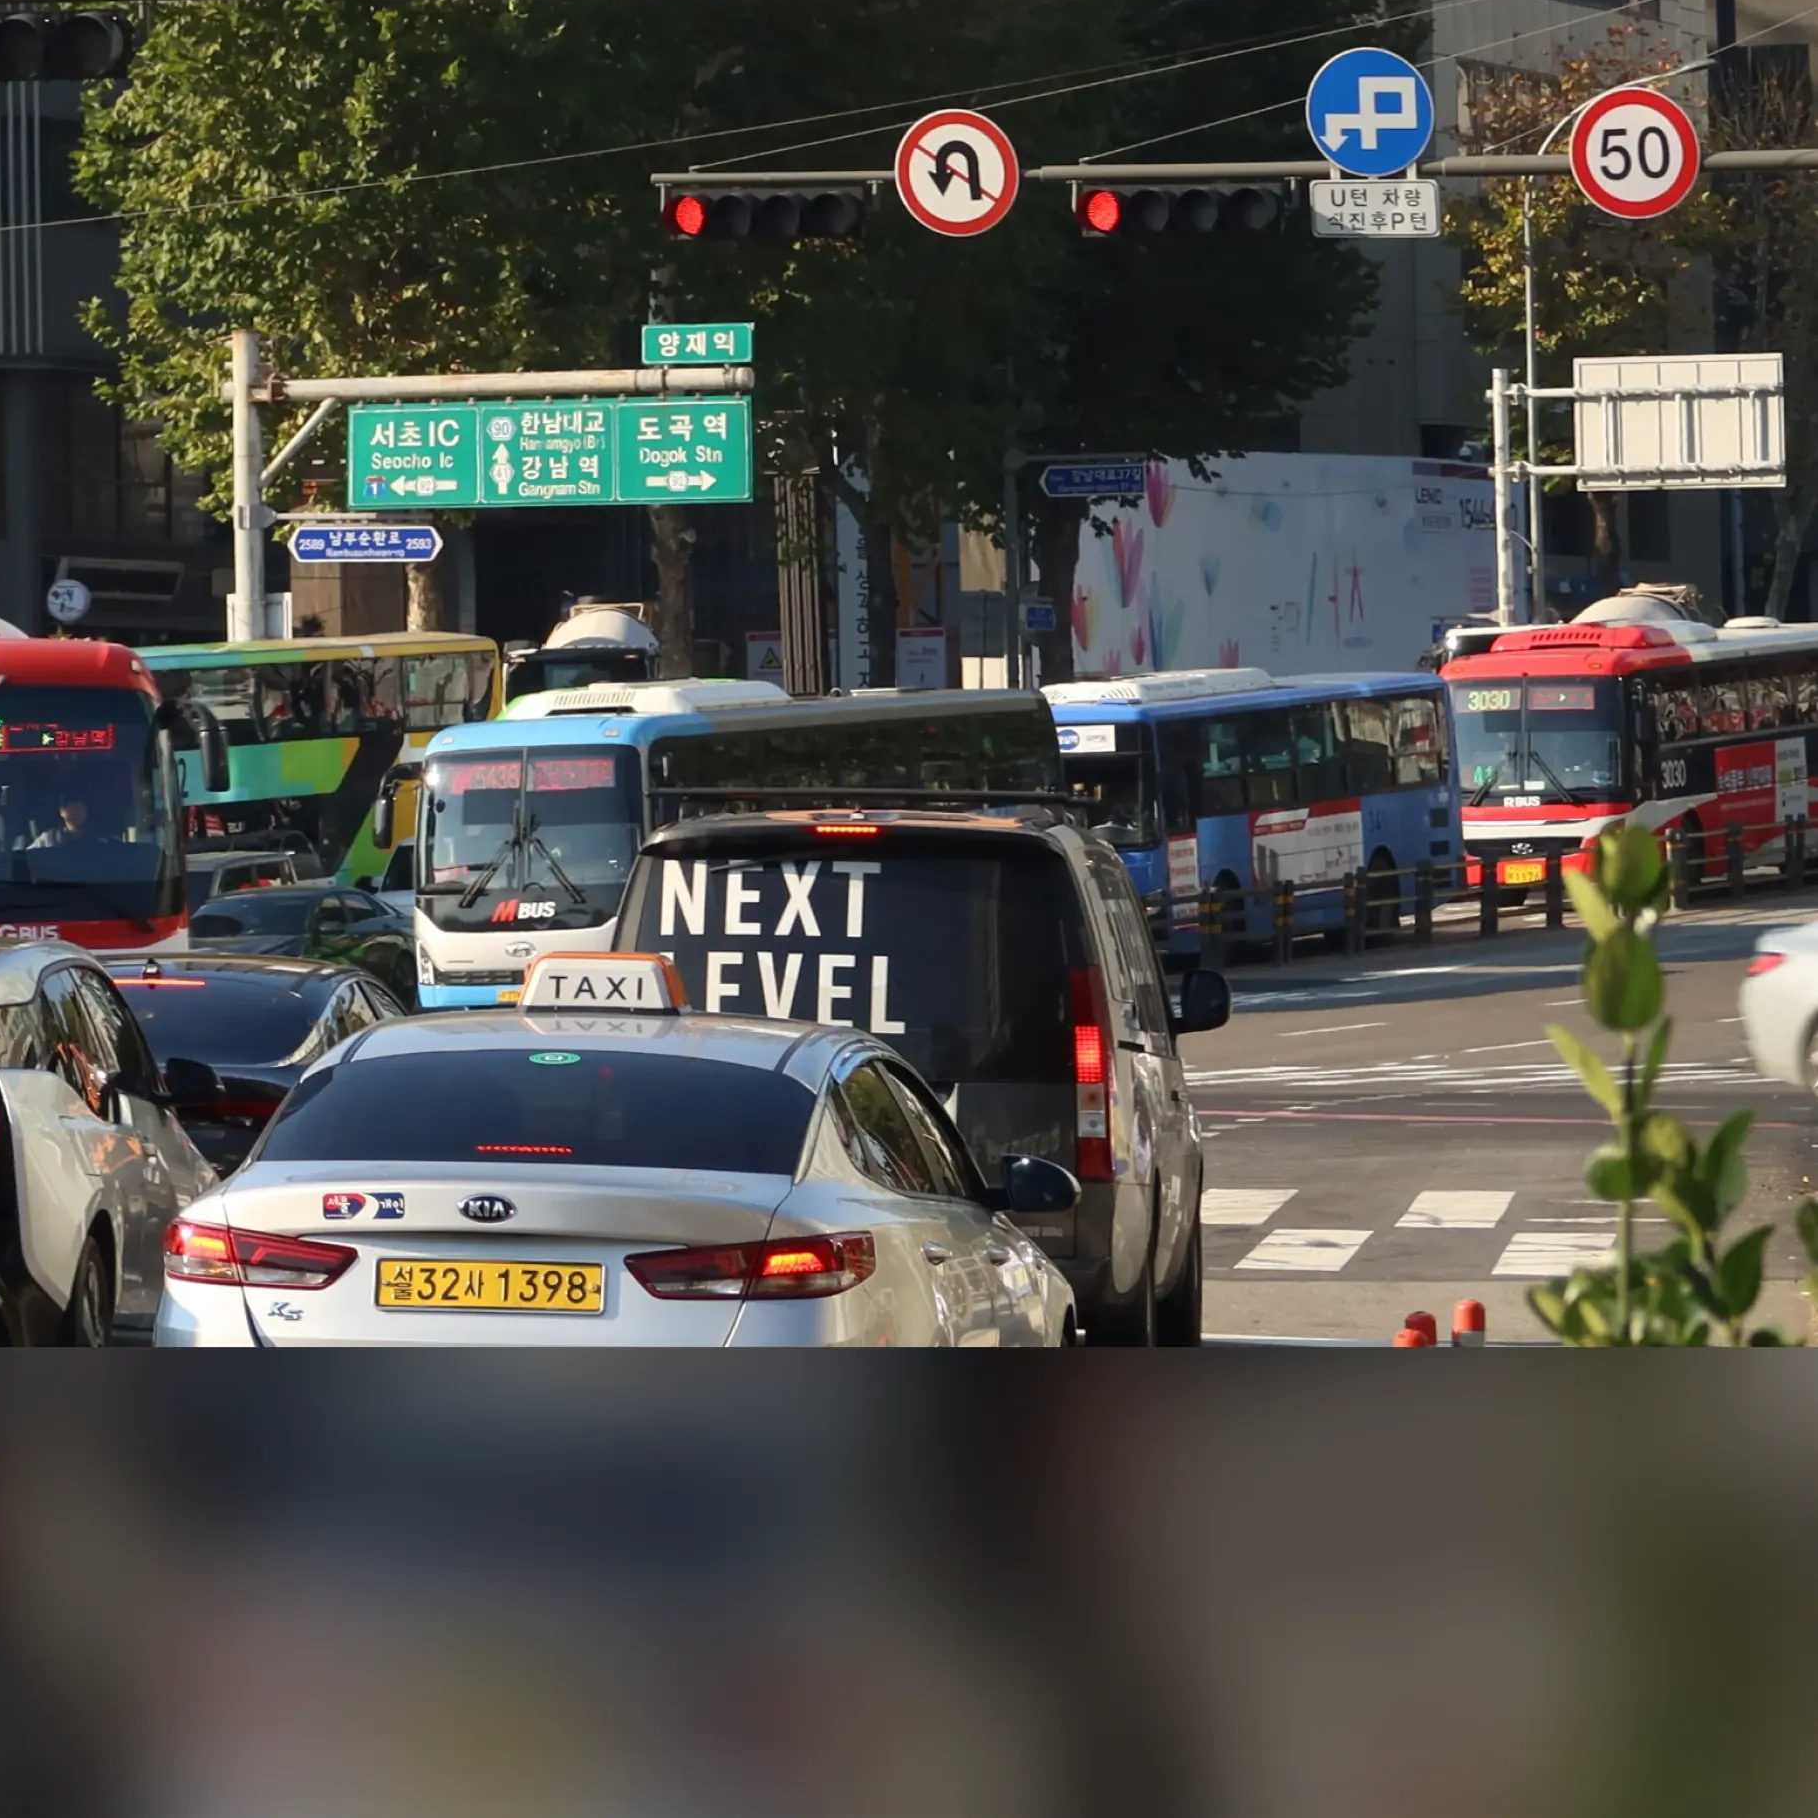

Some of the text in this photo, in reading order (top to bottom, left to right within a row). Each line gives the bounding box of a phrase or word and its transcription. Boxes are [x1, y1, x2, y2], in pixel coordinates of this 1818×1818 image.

[1600, 126, 1670, 180] 50
[1330, 188, 1421, 207] U턴 차량
[520, 411, 605, 435] 한남대교
[637, 412, 727, 442] 도곡역
[371, 452, 432, 470] Seocho
[521, 455, 599, 480] 강남역
[639, 446, 723, 467] Dogok Stn
[518, 484, 576, 499] Gangnam
[1468, 690, 1511, 710] 3030
[1661, 759, 1687, 789] 3030
[660, 859, 881, 938] NEXT
[549, 976, 644, 1000] TAXI
[660, 951, 906, 1034] EVEL
[466, 1200, 507, 1218] KIA
[497, 1270, 589, 1305] 1398
[268, 1301, 303, 1321] K5
